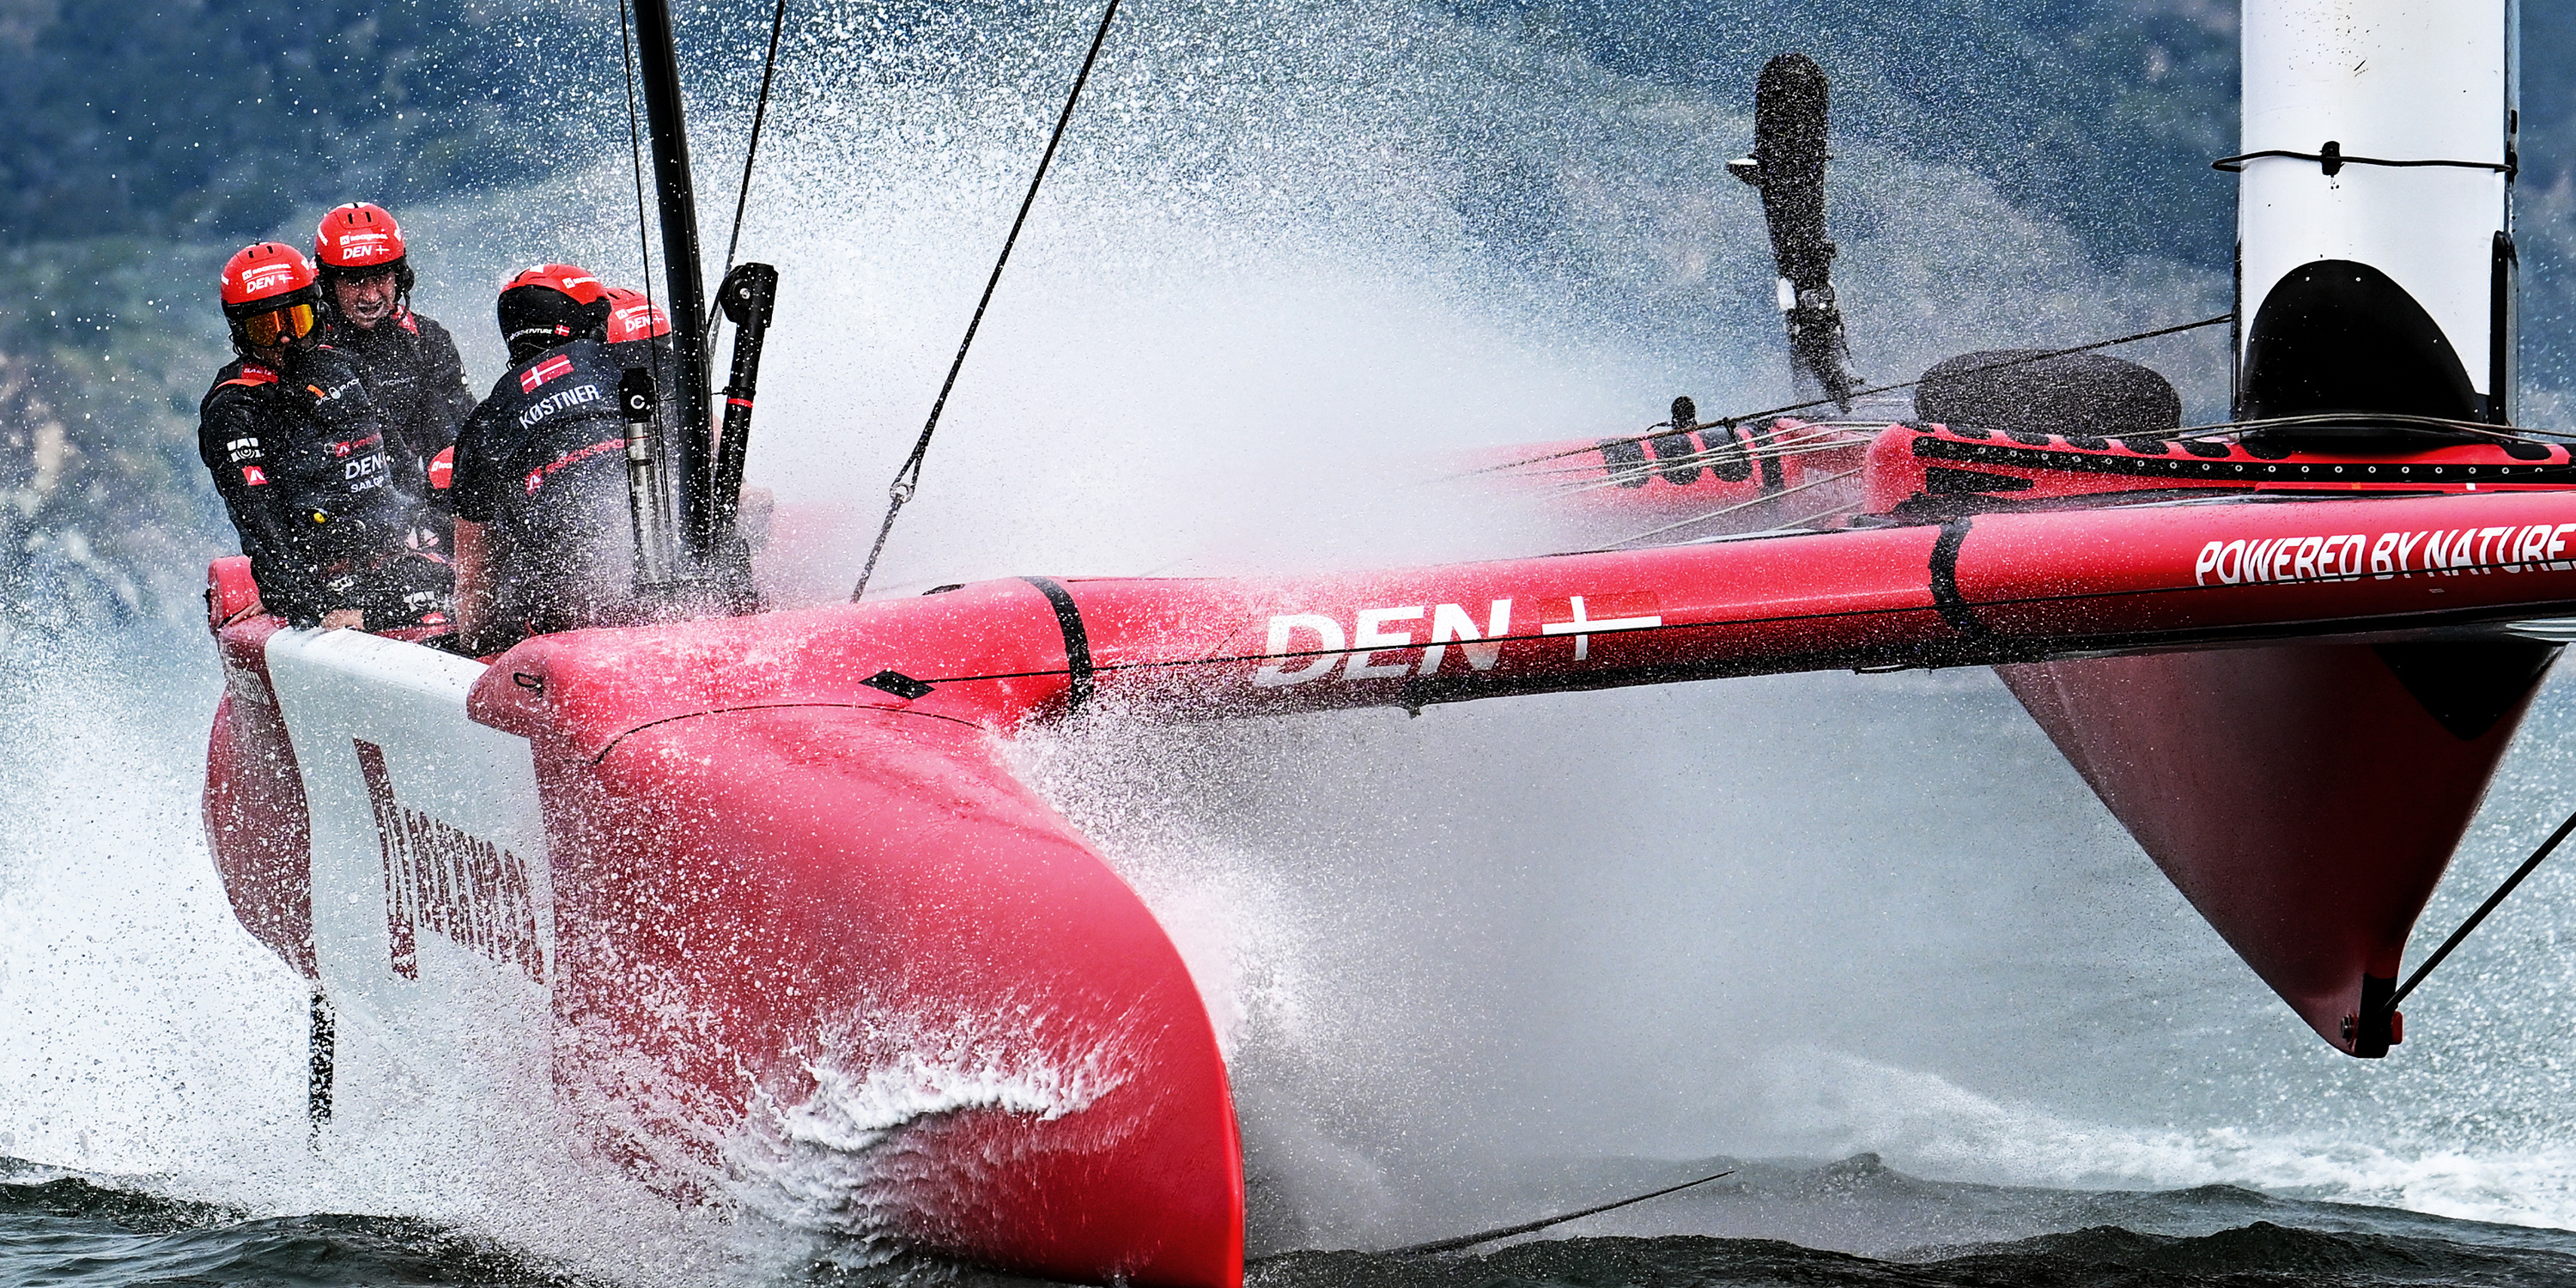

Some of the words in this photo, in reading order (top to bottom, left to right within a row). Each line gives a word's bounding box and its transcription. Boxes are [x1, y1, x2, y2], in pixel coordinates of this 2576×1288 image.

[343, 245, 372, 260] DEN
[246, 275, 275, 294] DEN
[625, 314, 651, 333] DEN
[519, 384, 601, 429] KØSTNER
[345, 452, 382, 480] DEN
[2196, 534, 2367, 587] POWERED
[2370, 530, 2428, 580] BY
[2424, 523, 2576, 578] NATURE
[1254, 598, 1512, 687] DEN
